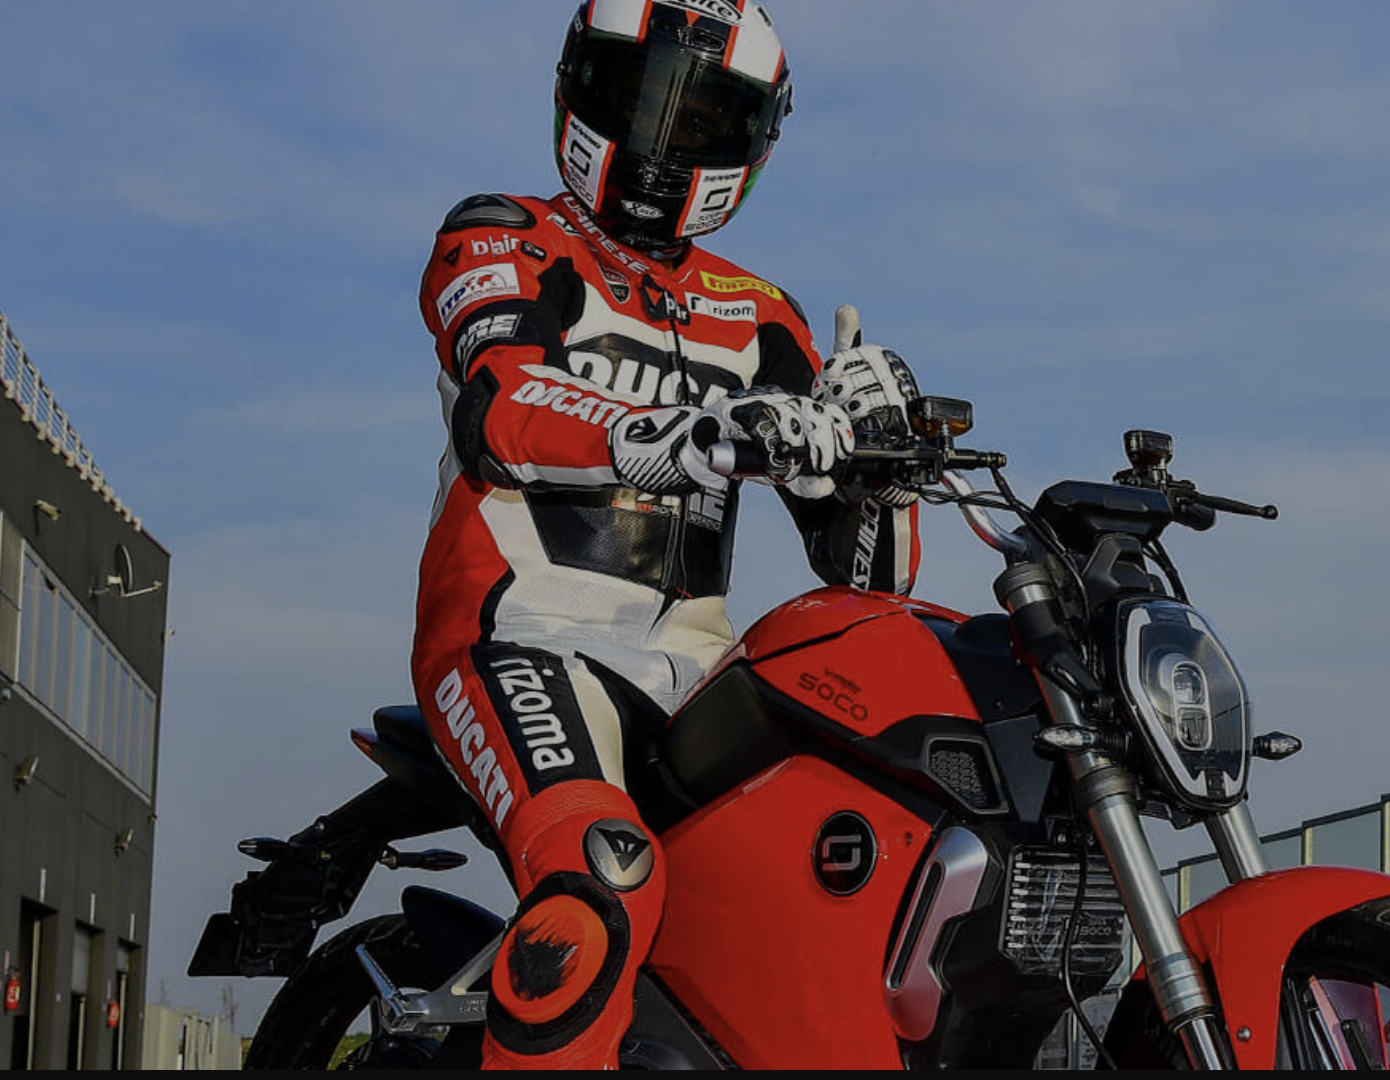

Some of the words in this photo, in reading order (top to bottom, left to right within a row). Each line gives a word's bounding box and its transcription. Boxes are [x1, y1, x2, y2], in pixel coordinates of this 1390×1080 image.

[510, 380, 630, 429] DUCATI
[489, 657, 575, 770] rizoma
[798, 672, 869, 721] SOCO
[435, 667, 514, 829] DUCATI
